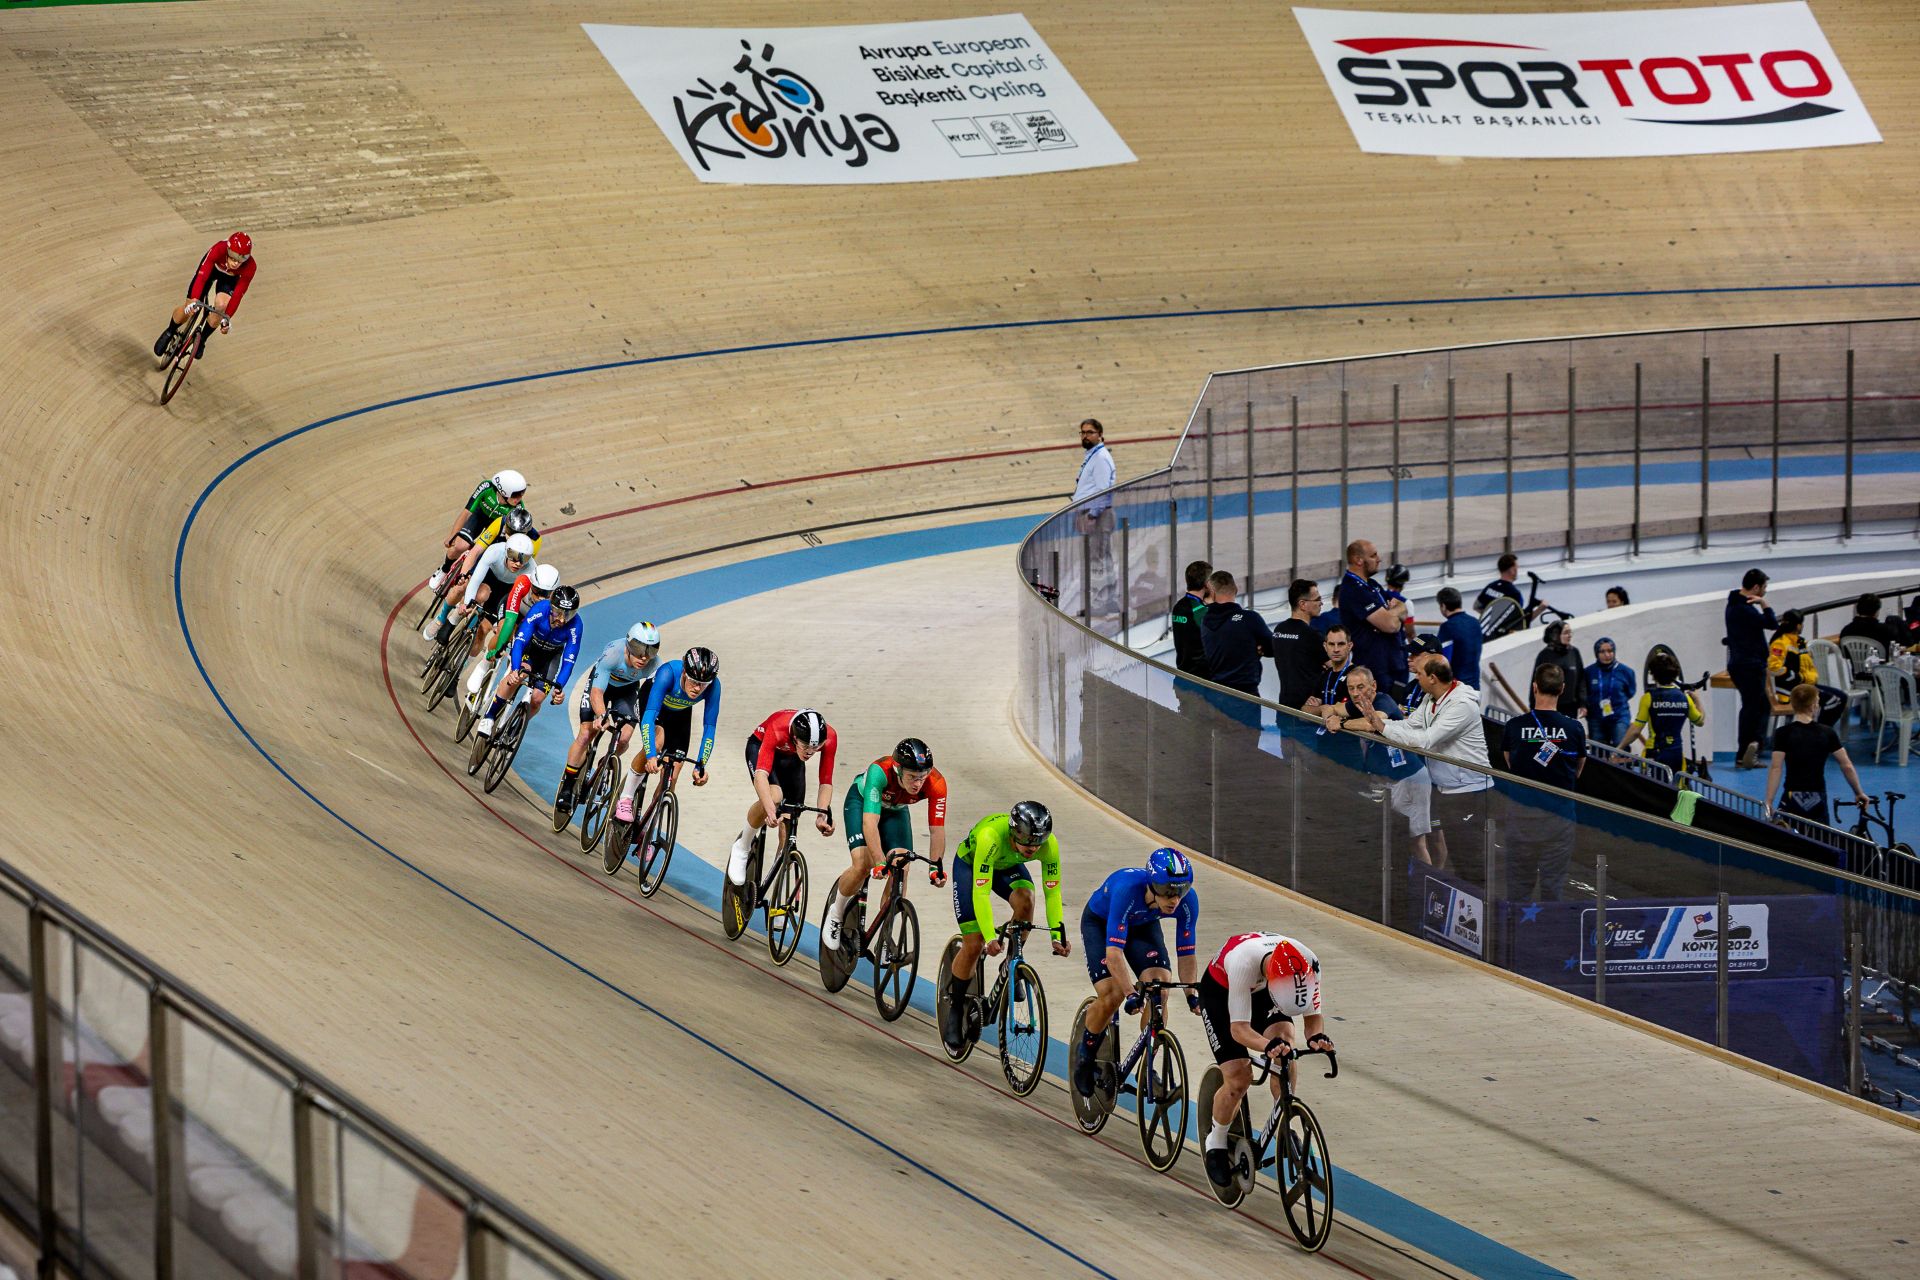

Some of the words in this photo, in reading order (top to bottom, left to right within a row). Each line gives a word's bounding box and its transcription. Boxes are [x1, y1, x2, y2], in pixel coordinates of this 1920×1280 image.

[859, 44, 932, 61] Avrupa
[932, 36, 1031, 56] European
[872, 64, 950, 82] Bisiklet
[951, 57, 1027, 78] Capital
[1028, 54, 1048, 71] of
[876, 85, 967, 107] Başkenti
[969, 81, 1046, 102] Cycling
[1364, 112, 1461, 125] TEŞKİLAT
[1474, 115, 1600, 127] BAŞKANLIĞI
[673, 96, 900, 171] Konya
[947, 134, 960, 142] MY
[961, 132, 980, 141] CITY
[495, 477, 507, 497] POC
[510, 582, 525, 611] PORTUGAL
[1653, 701, 1688, 709] UKRAINE
[642, 723, 651, 755] SWEDEN
[1521, 727, 1567, 739] ITALIA
[935, 797, 945, 818] HUN
[848, 833, 864, 845] UN
[953, 881, 962, 919] SLOVENIA
[1615, 930, 1645, 941] UEC
[1728, 940, 1759, 951] 2026
